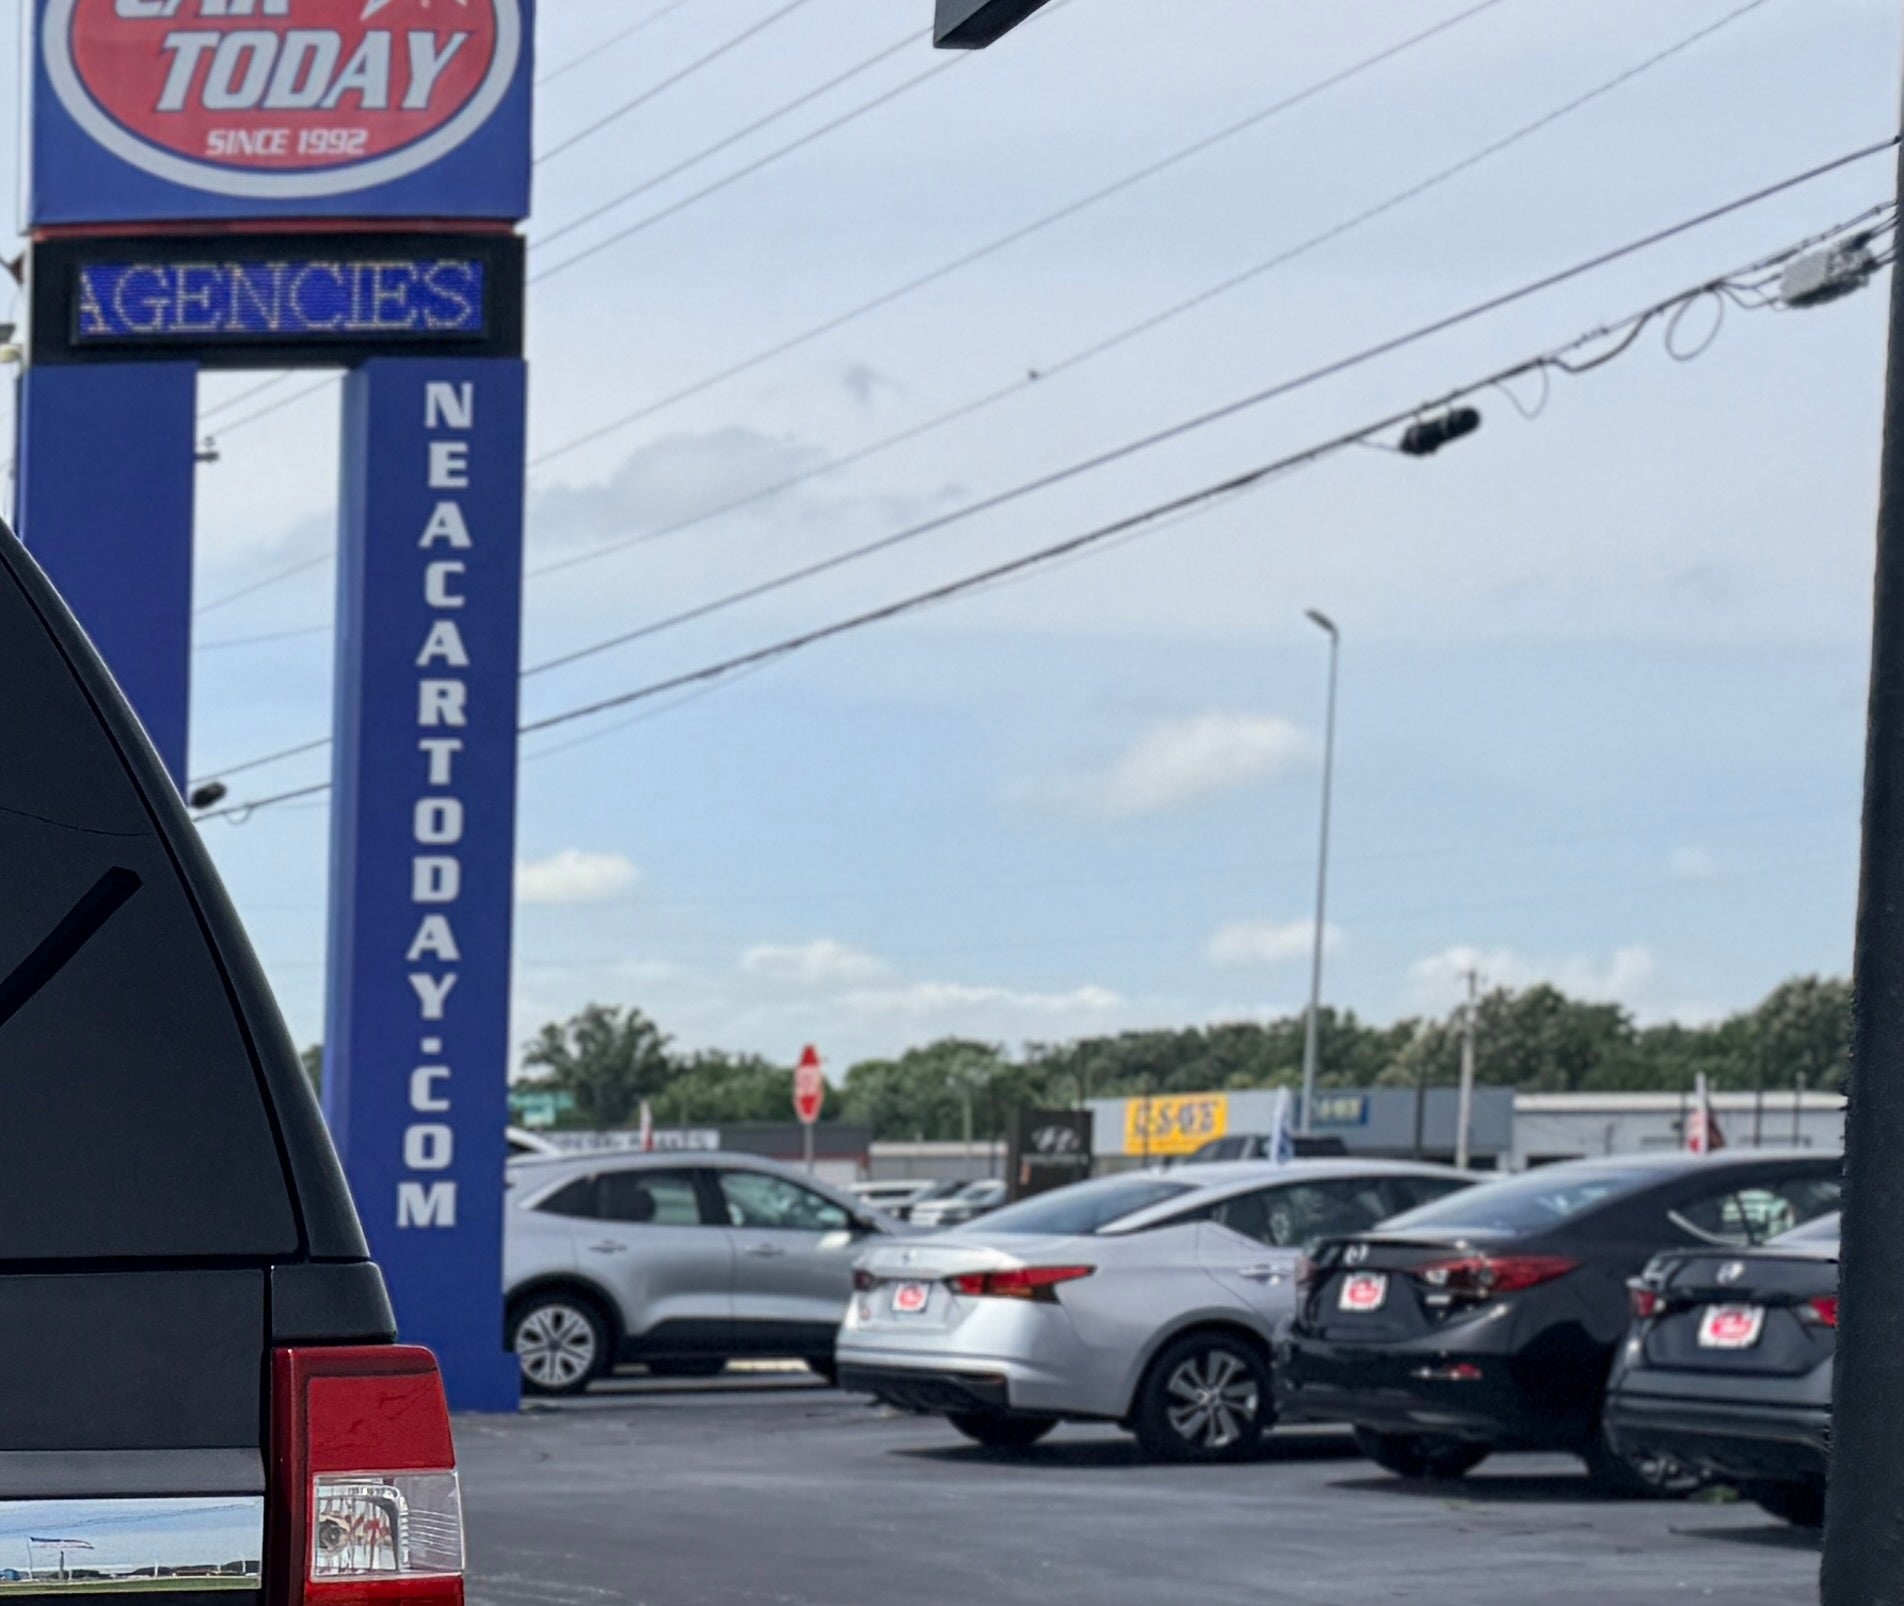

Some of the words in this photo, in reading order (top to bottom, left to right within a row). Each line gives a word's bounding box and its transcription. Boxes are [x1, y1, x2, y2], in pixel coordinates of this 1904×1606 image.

[154, 29, 470, 112] TODAY
[205, 129, 290, 156] SINCE
[297, 128, 369, 156] 1992
